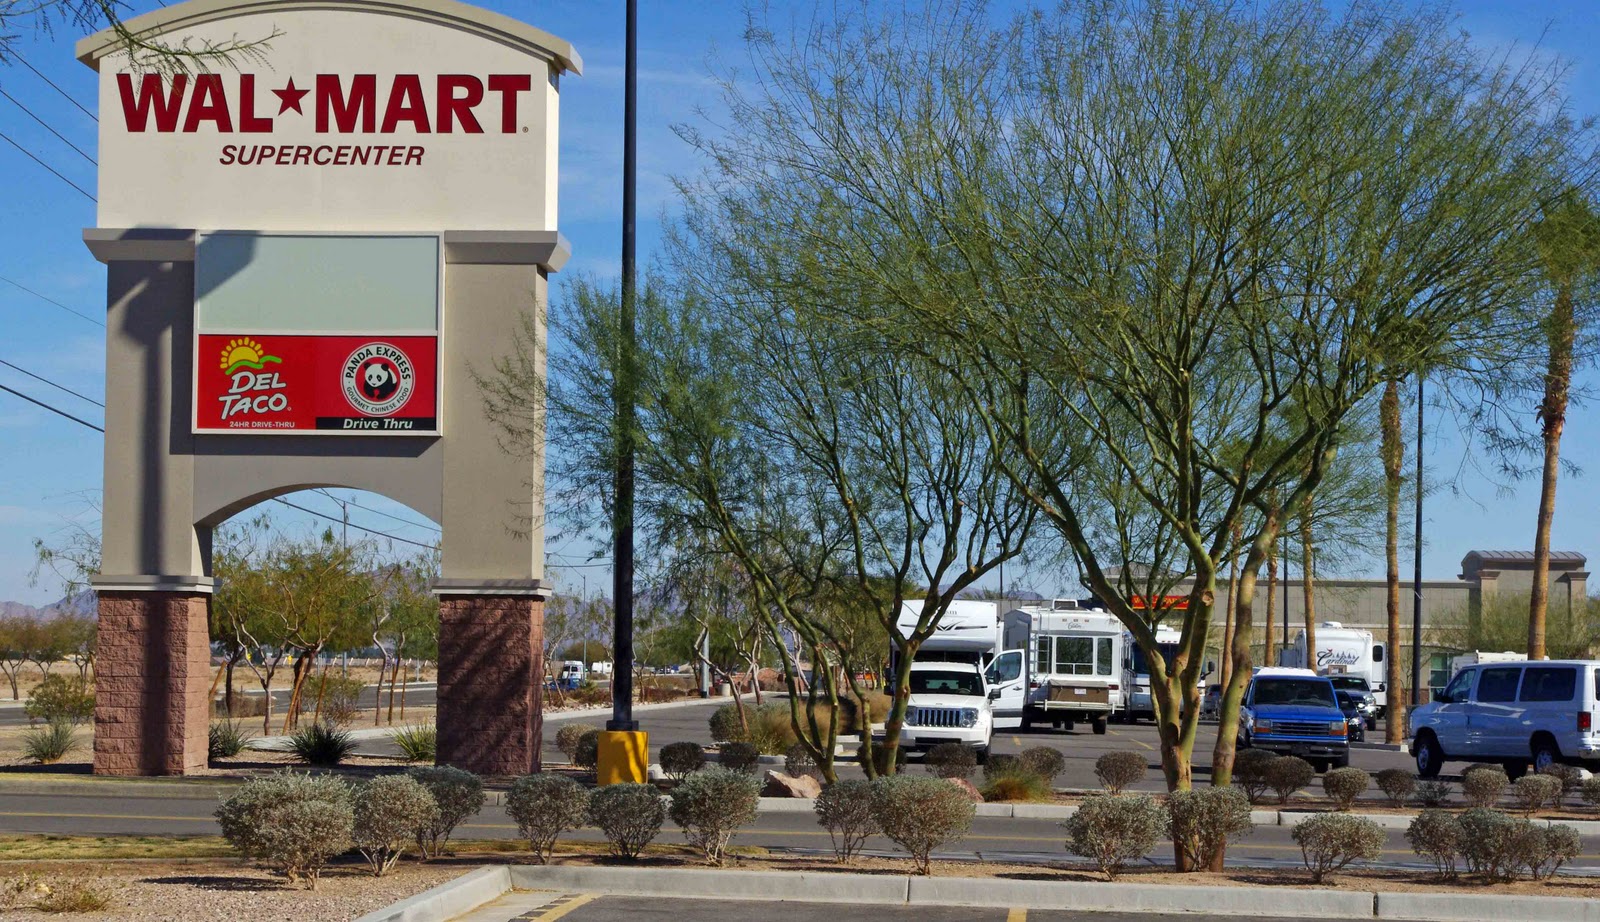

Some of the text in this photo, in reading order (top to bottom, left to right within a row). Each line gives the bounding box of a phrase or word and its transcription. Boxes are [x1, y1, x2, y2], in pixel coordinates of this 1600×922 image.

[219, 144, 425, 166] SUPERCENTER
[345, 346, 411, 380] PANDA EXPRESS
[228, 371, 287, 394] DEL
[218, 392, 288, 420] TACO
[346, 386, 409, 413] GOURMET CHINESE FOOD
[343, 418, 413, 429] Drive Thru
[1316, 650, 1360, 667] Cardinal
